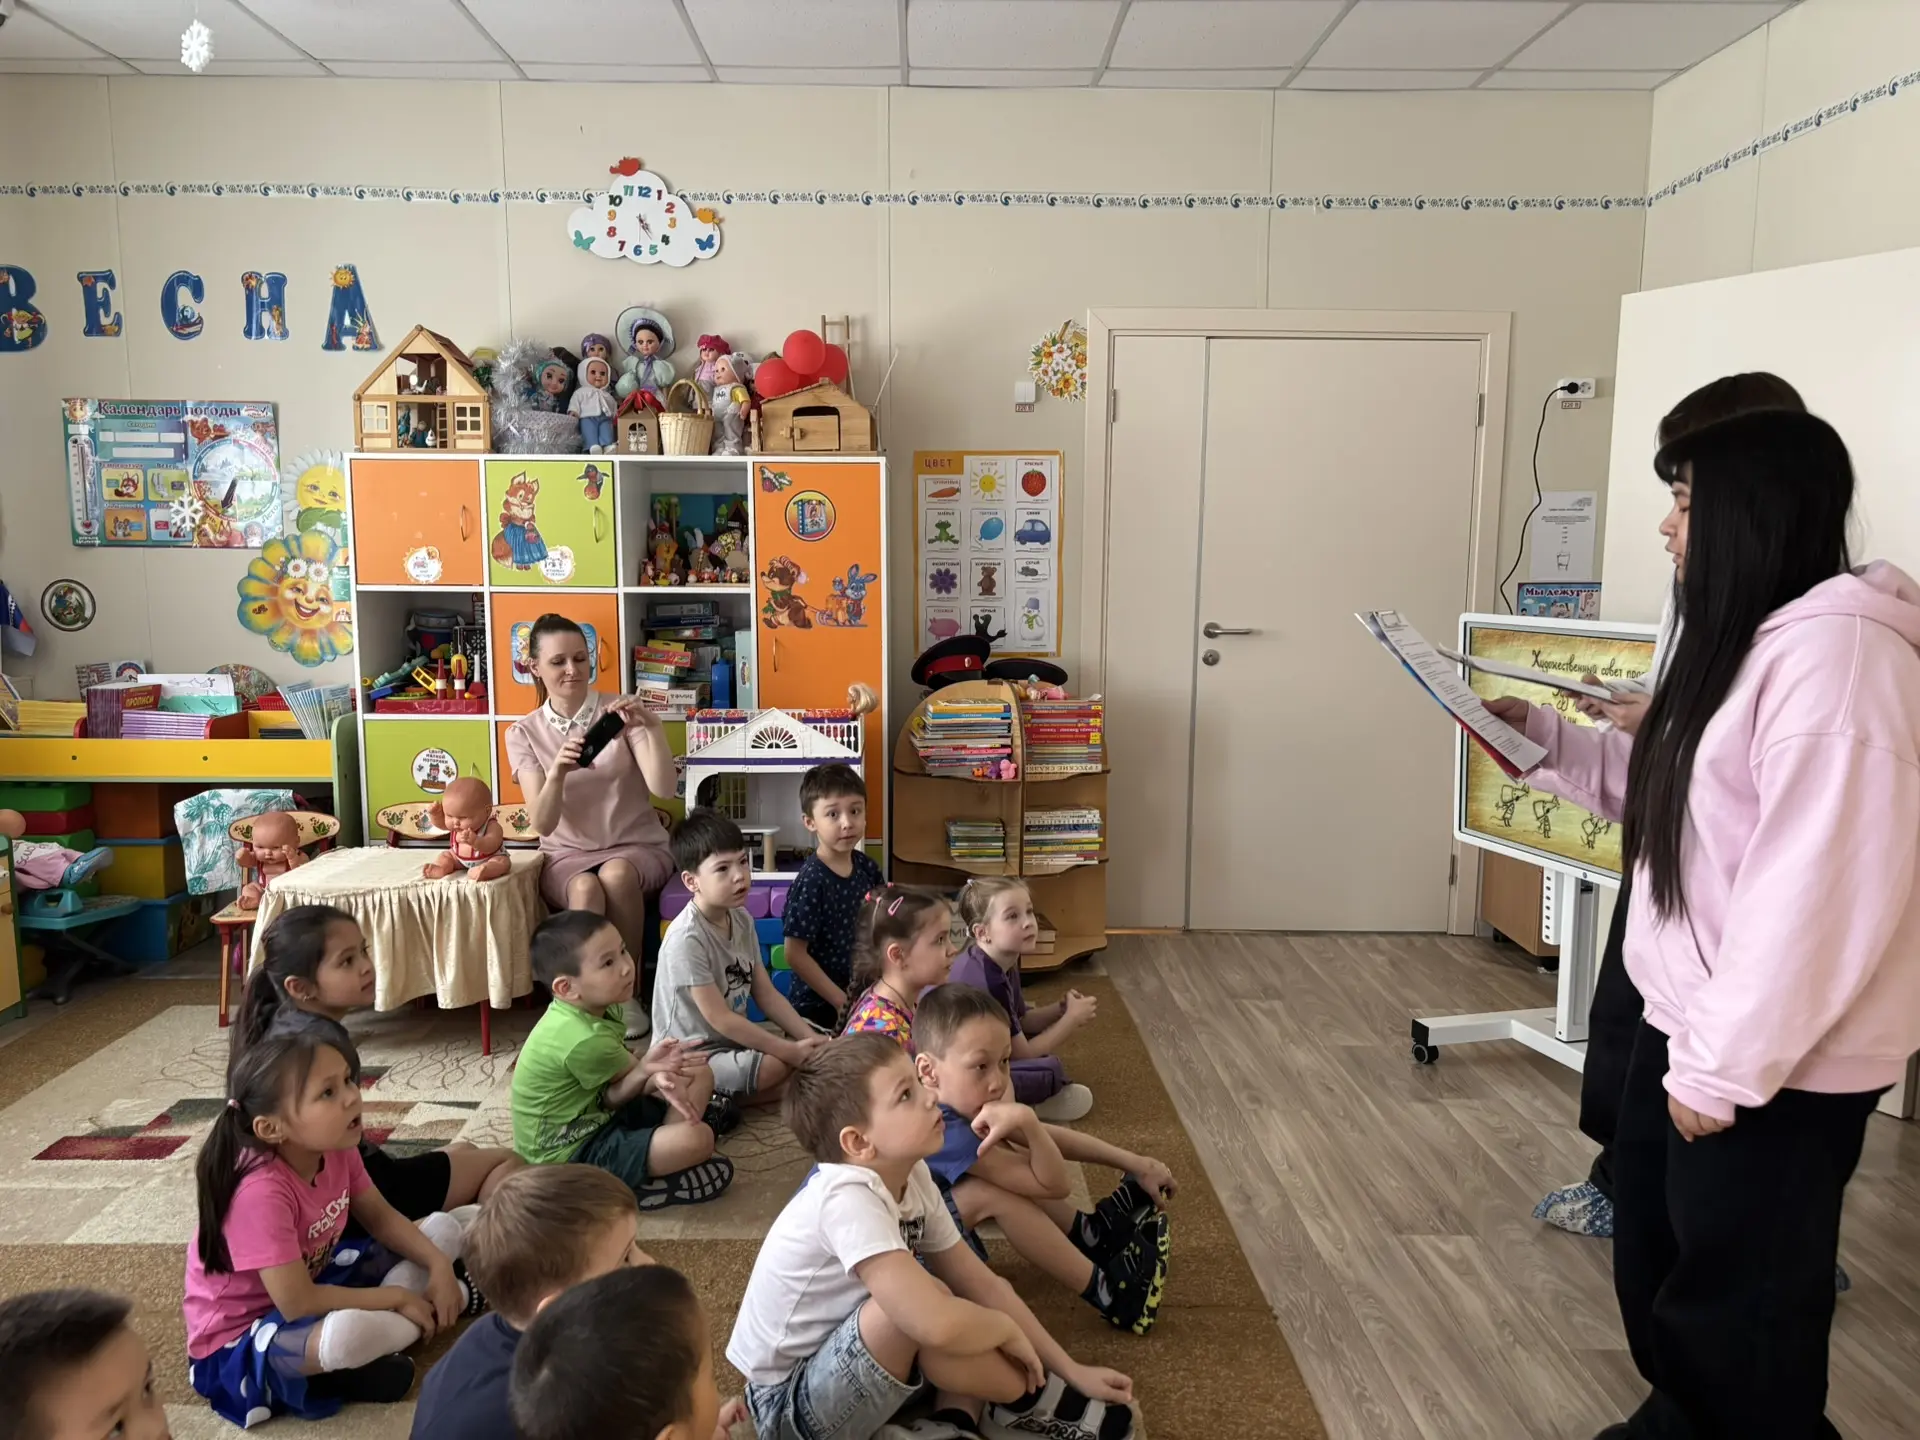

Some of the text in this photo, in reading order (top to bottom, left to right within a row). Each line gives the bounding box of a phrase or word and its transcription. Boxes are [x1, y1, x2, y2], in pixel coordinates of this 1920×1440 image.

[623, 185, 634, 196] 11
[637, 186, 652, 198] 12
[656, 189, 663, 200] 1
[608, 194, 623, 207] 10
[665, 202, 675, 213] 2
[607, 209, 617, 221] 9
[667, 217, 677, 229] 3
[606, 226, 617, 237] 8
[661, 234, 670, 245] 4
[617, 240, 626, 251] 7
[632, 245, 643, 256] 6
[648, 244, 659, 255] 5
[0, 264, 382, 352] ВЕСНА
[97, 401, 181, 418] Календарь
[185, 406, 241, 418] погоды
[924, 458, 954, 469] ЦВЕТ
[1525, 587, 1599, 597] Мы дежур
[1532, 650, 1598, 675] Художественный
[1600, 657, 1623, 678] совет
[125, 695, 155, 708] ПРОПИСИ
